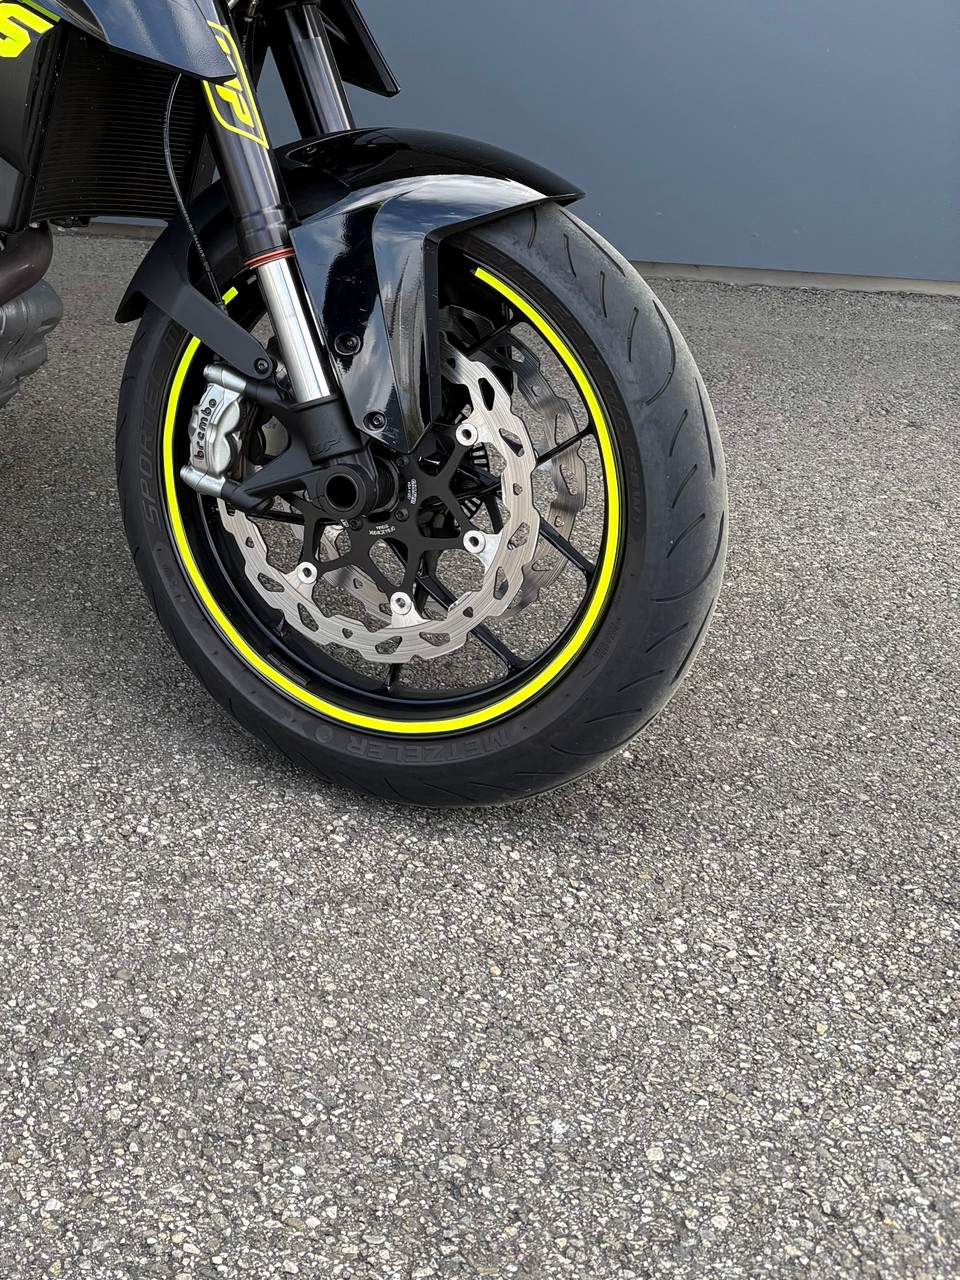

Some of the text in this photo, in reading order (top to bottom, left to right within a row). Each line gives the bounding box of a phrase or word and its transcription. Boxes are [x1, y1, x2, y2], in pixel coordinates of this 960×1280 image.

[141, 367, 165, 532] SPORTEC
[194, 398, 217, 460] brembo
[346, 728, 510, 762] METZELER
